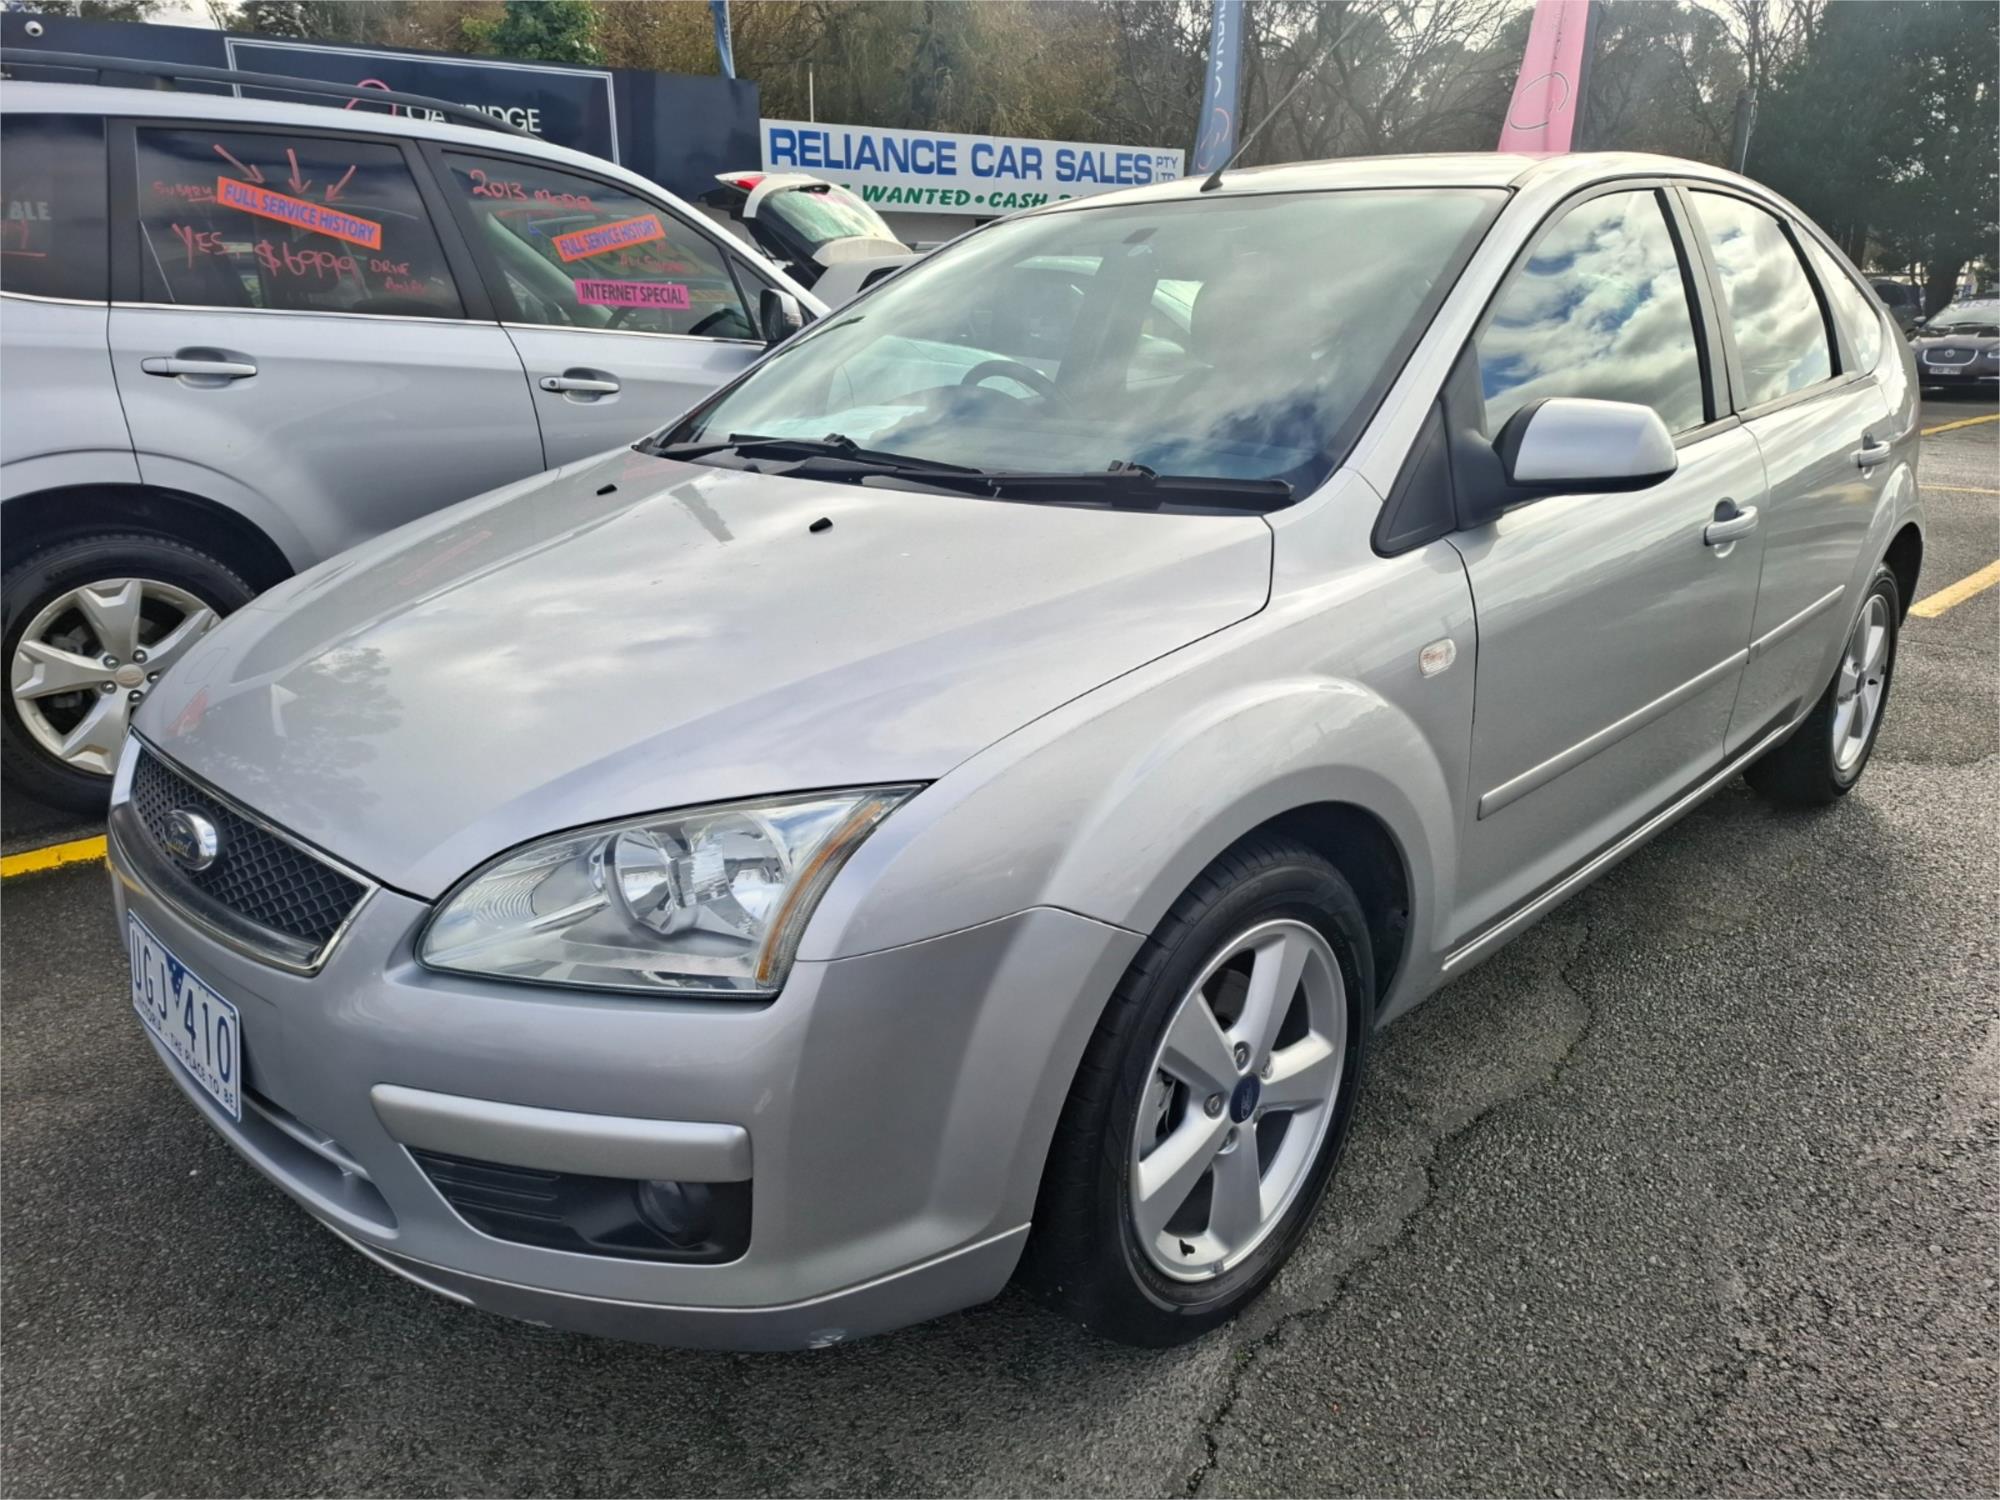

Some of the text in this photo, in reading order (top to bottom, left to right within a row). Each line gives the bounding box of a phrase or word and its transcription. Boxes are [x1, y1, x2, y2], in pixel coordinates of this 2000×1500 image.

[769, 128, 1152, 184] RELIANCE CAR SALES
[1156, 156, 1178, 169] PTY
[470, 169, 527, 200] 2013
[862, 184, 1048, 208] WANTED CASH
[224, 184, 376, 243] FULL SERVICE HISTORY
[560, 220, 657, 256] FULL SERVICE HISTORY
[254, 240, 361, 284] $6999
[581, 283, 685, 304] INTERNET SPECIAL
[131, 926, 231, 1083] UGJ 410
[207, 1072, 220, 1094] TO
[223, 1087, 234, 1109] BE
